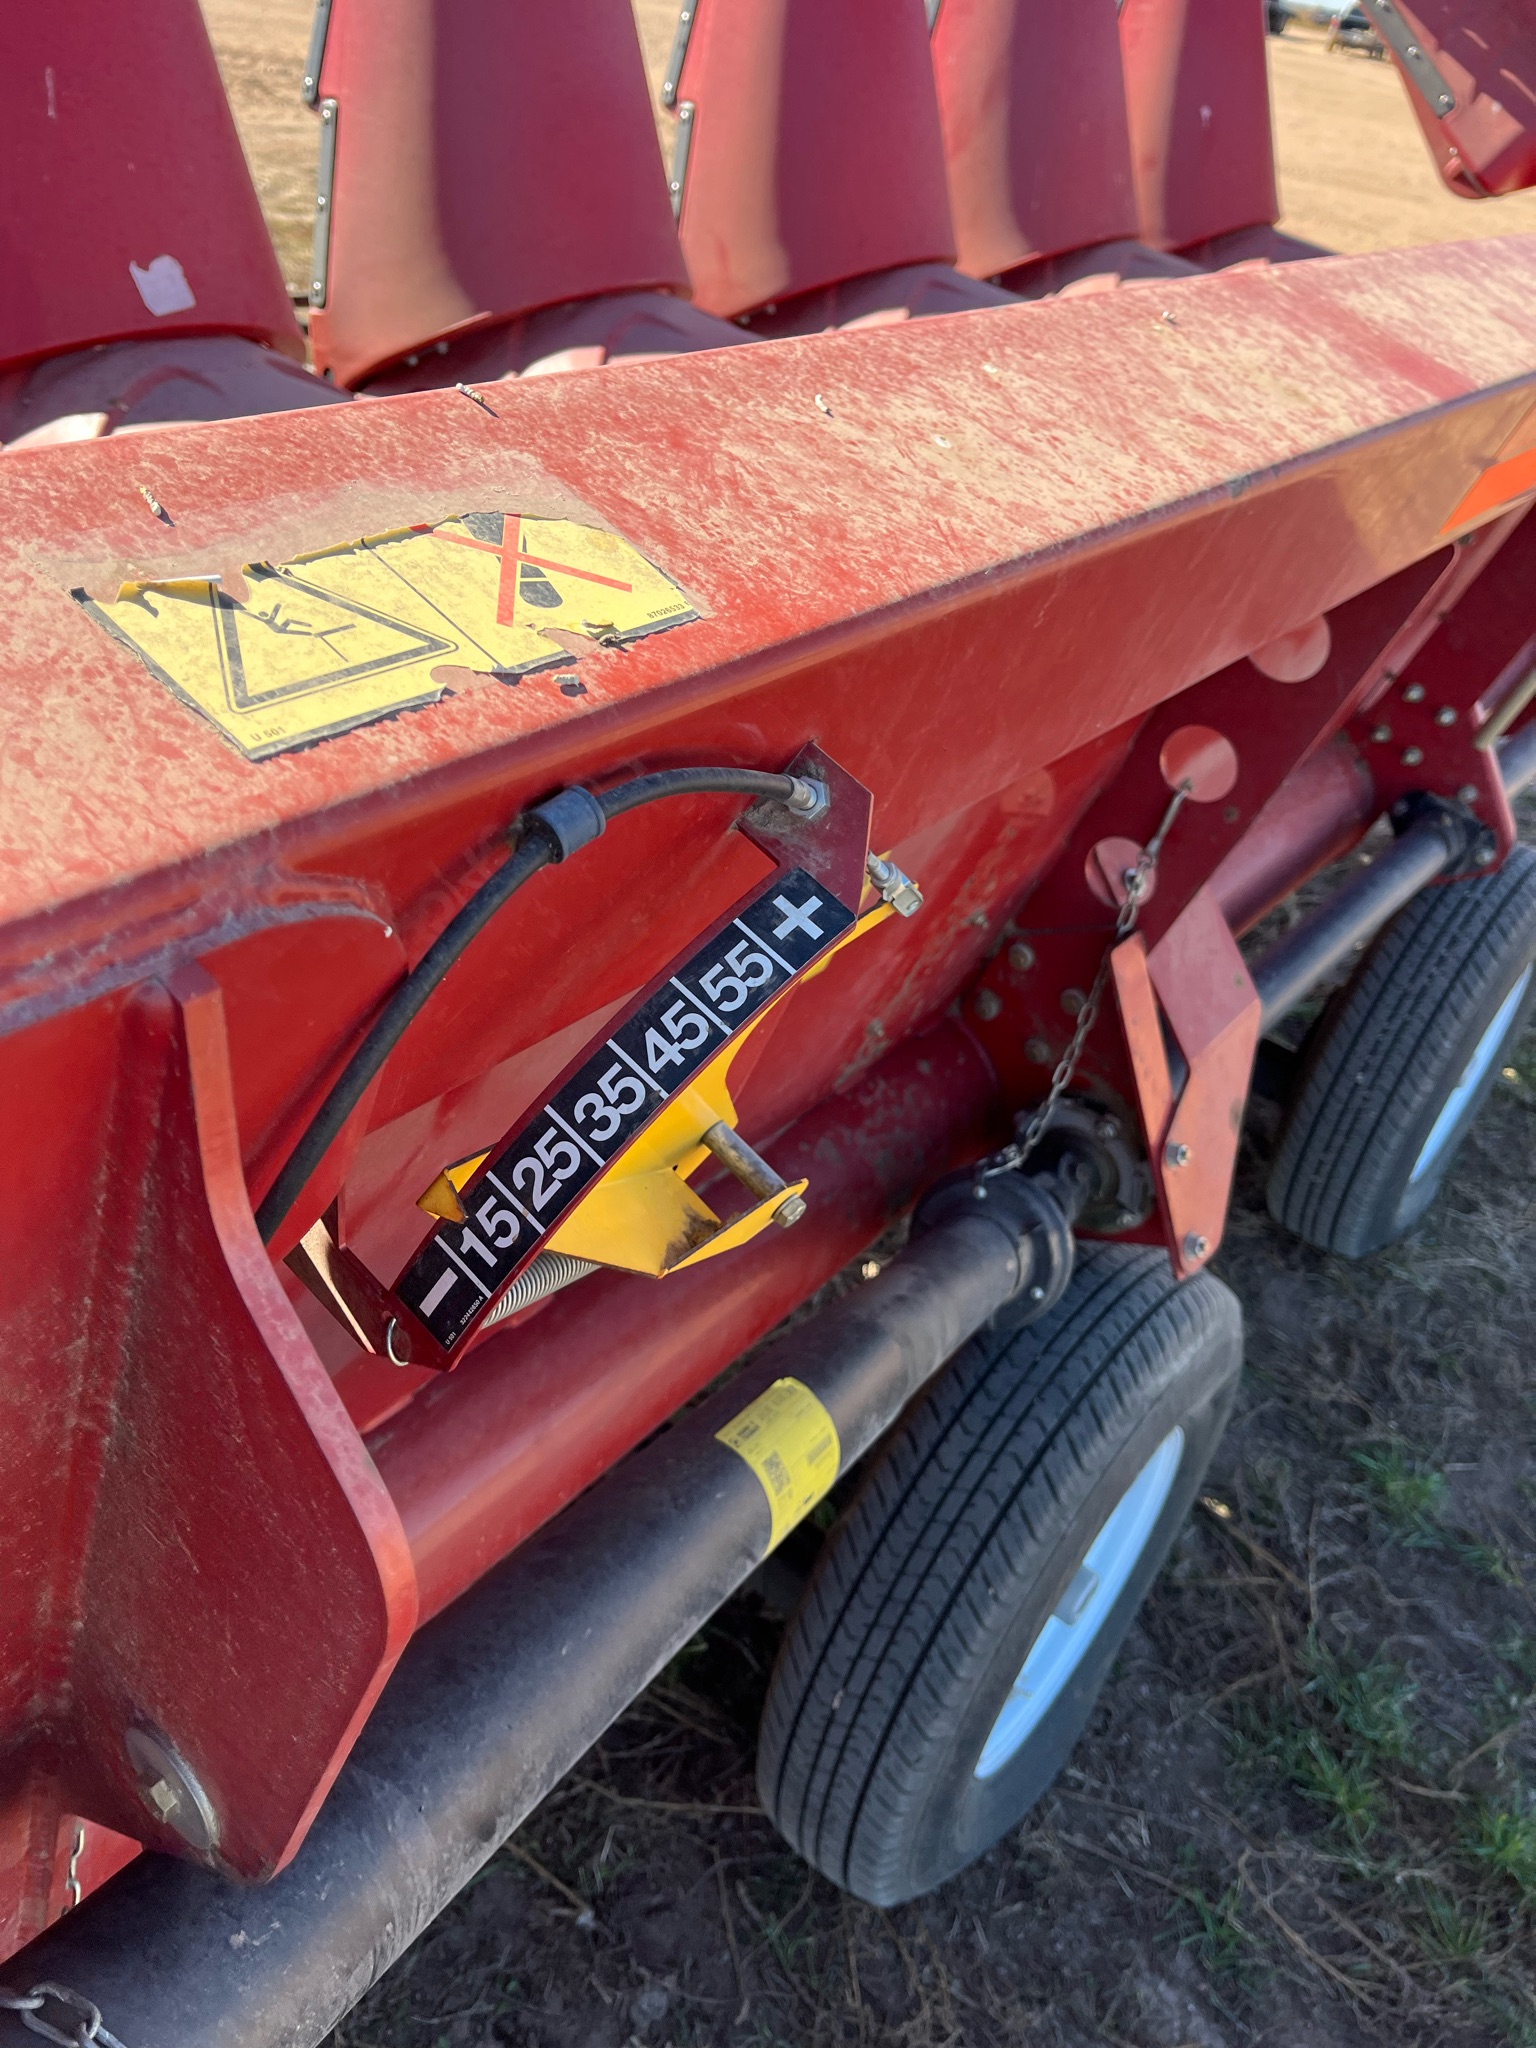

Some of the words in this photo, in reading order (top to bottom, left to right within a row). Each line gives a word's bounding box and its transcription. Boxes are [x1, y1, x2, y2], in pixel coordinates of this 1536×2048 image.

[249, 732, 263, 742] U
[460, 1195, 520, 1267] 15
[513, 1127, 580, 1212] 25
[574, 1062, 646, 1141] 35
[645, 999, 709, 1074] 45
[699, 939, 773, 1012] 55
